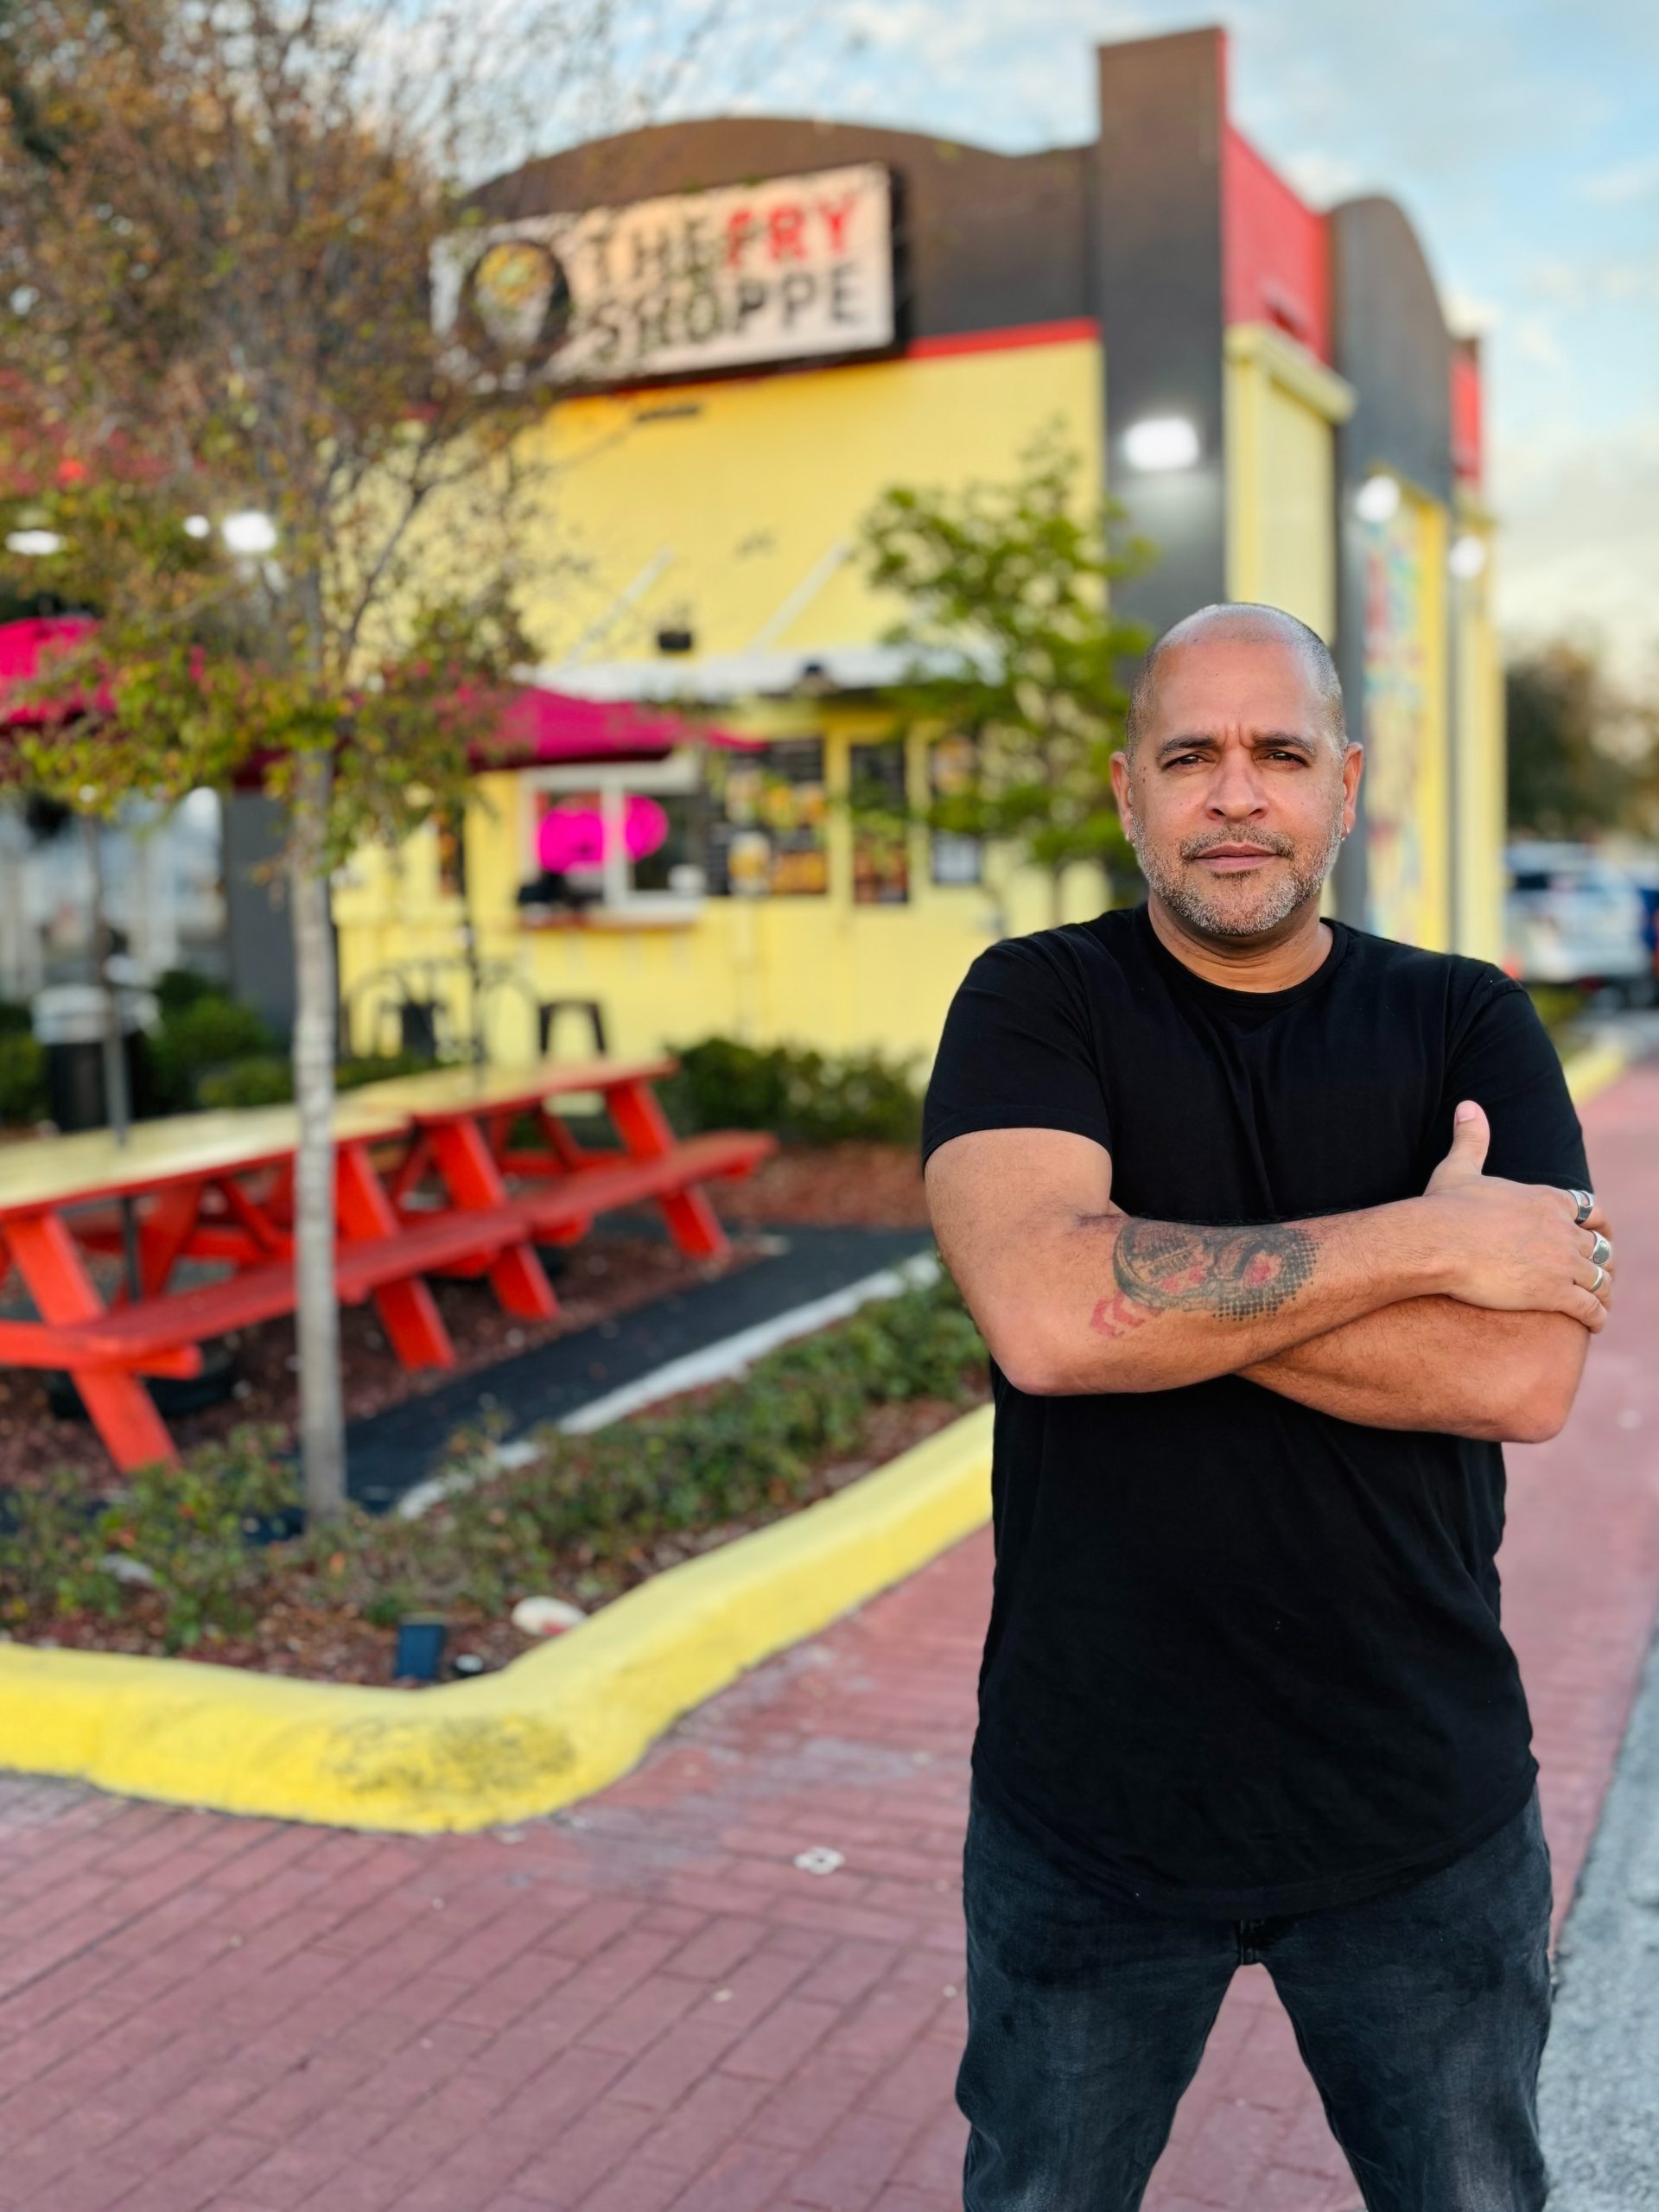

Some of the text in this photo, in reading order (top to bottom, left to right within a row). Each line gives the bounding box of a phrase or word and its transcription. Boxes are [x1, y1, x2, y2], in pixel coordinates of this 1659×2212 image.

[582, 197, 857, 285] THE FRY
[592, 263, 861, 358] SHOPPE
